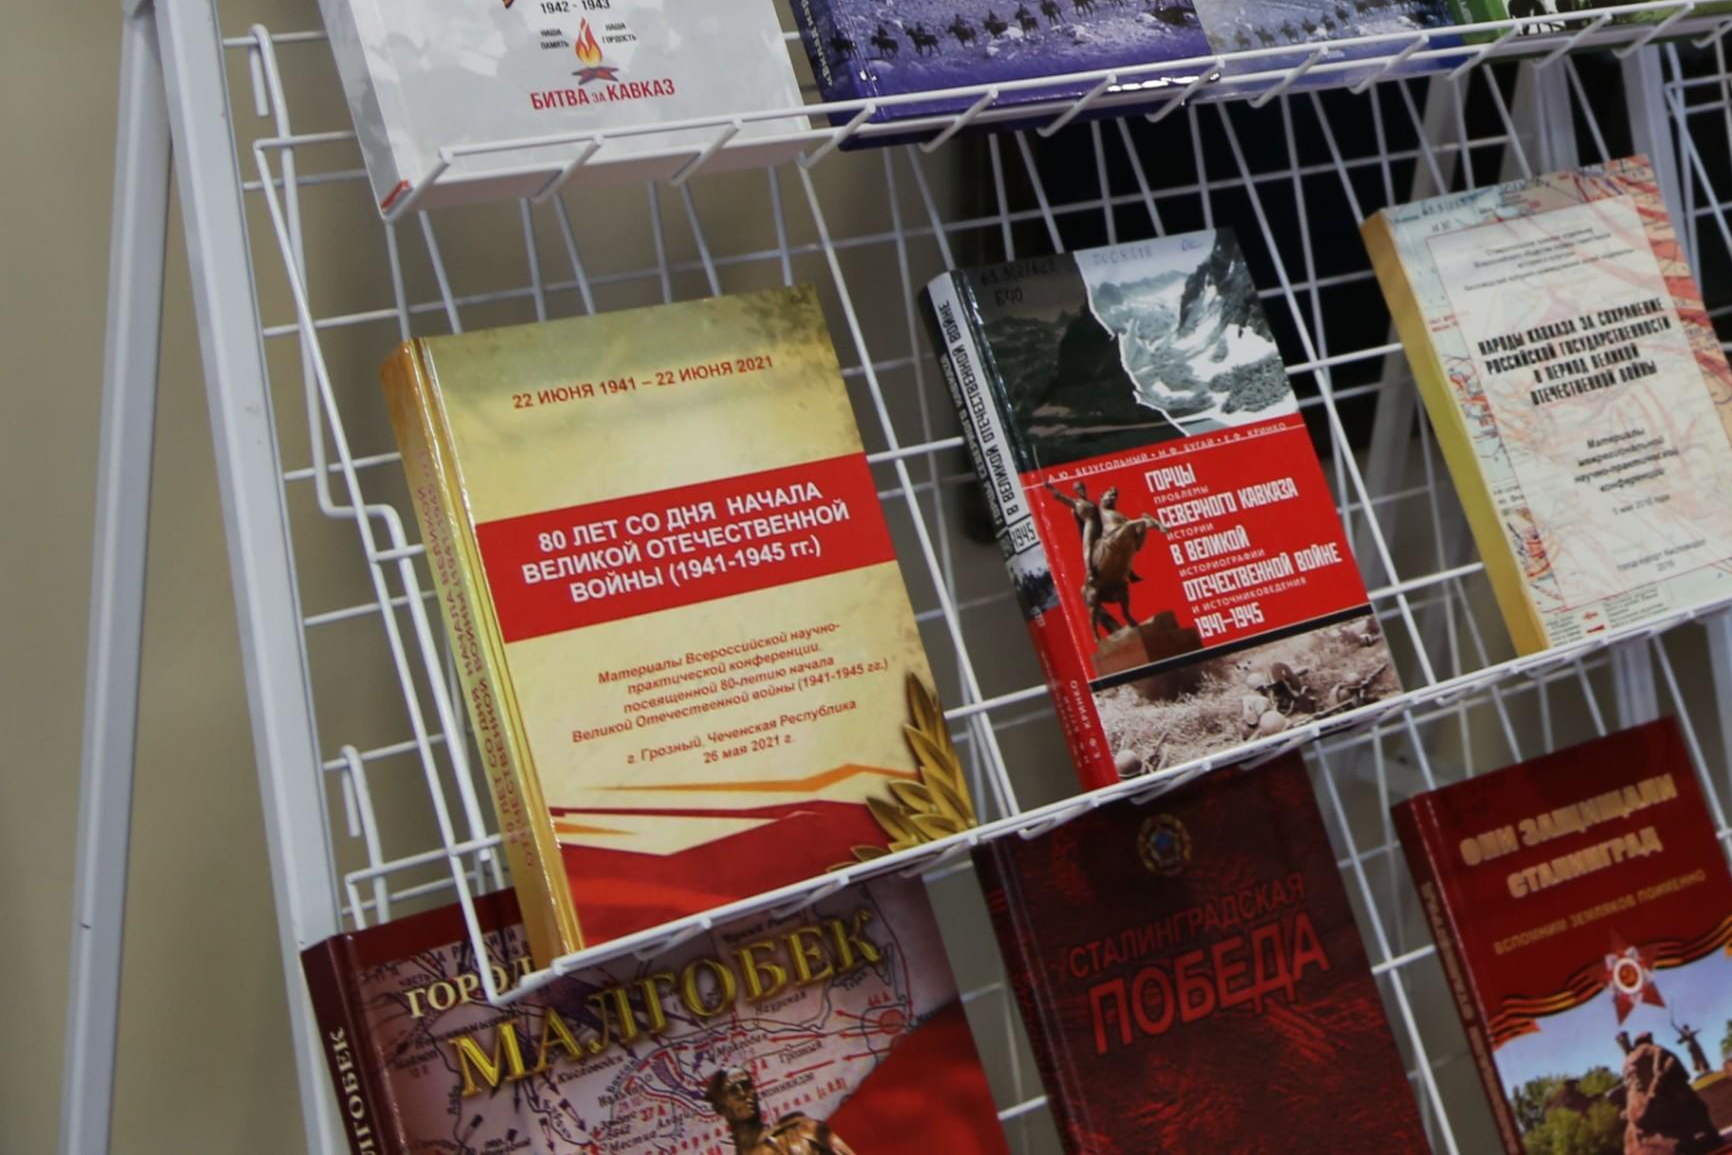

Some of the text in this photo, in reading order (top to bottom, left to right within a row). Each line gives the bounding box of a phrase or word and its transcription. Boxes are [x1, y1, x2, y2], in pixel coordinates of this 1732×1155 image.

[540, 1, 570, 15] 1942
[530, 77, 676, 111] БИТВА ЗА КАВКАЗ
[1477, 296, 1665, 356] НАРОДЫ КАВКАЗА ЗА СОХРАНЕНИЕ
[1485, 315, 1672, 376] РОССИЙСКОЙ ГОСУДАРСТВЕННОСТИ
[512, 355, 775, 410] 22 ИЮНЯ 1941 22 ИЮНЯ 2021
[1144, 463, 1197, 494] ГОРЦЫ
[1153, 485, 1209, 505] ПРОБЛЕМЫ
[1156, 477, 1300, 529] СЕВЕРНОГО КАВКАЗА
[521, 498, 851, 585] ВЕЛИКОЙ ОТЕЧЕСТВЕННОЙ
[538, 481, 824, 554] 80 ЛЕТ СО ДНЯ НАЧАЛА
[1166, 523, 1215, 541] ИСТОРИИ
[1170, 524, 1250, 565] В ВЕЛИКОЙ
[569, 560, 664, 604] ВОЙНЫ
[668, 542, 786, 587] (1941-1945
[1179, 548, 1266, 577] ИСТОРИОГРАФИИ
[1182, 542, 1343, 602] ОТЕЧЕСТВЕННОЙ ВОЙНЕ
[598, 631, 788, 684] Материалы Всероссийской
[703, 749, 719, 764] 26
[722, 744, 749, 759] мая
[751, 734, 781, 752] 2021
[1458, 773, 1680, 868] ОНИ ЗАЩИЩАЛИ
[1506, 825, 1665, 900] СТАЛИНГРАД
[1067, 872, 1306, 979] СТАЛИНГРАДСКАЯ
[446, 909, 885, 1099] МАЛГОБЕК
[1087, 911, 1331, 1056] ПОБЕДА
